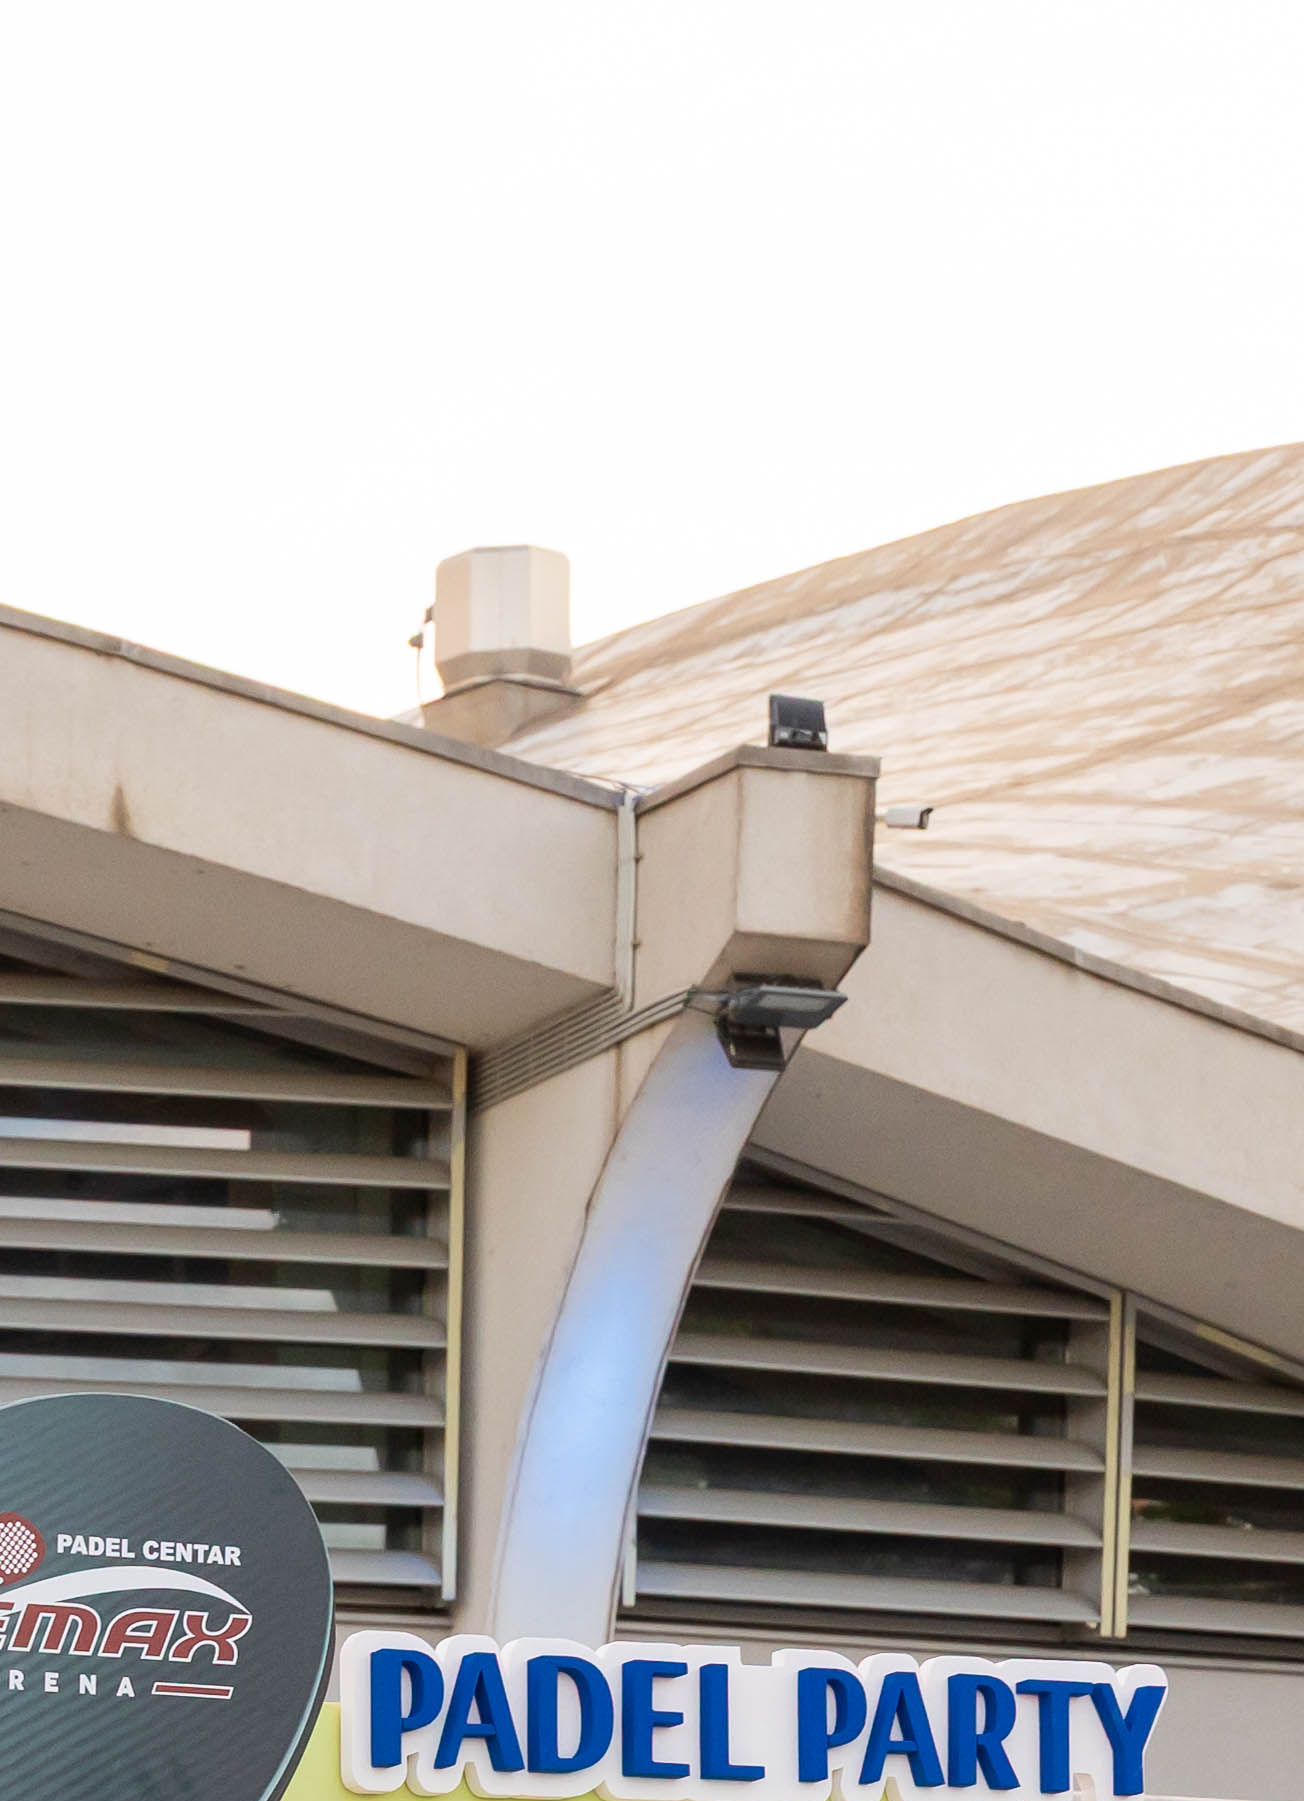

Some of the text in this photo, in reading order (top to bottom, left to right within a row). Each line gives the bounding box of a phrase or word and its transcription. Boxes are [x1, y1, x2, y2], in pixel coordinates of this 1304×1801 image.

[56, 1533, 242, 1566] PADEL CENTAR
[369, 1647, 1168, 1796] PADEL PARTY
